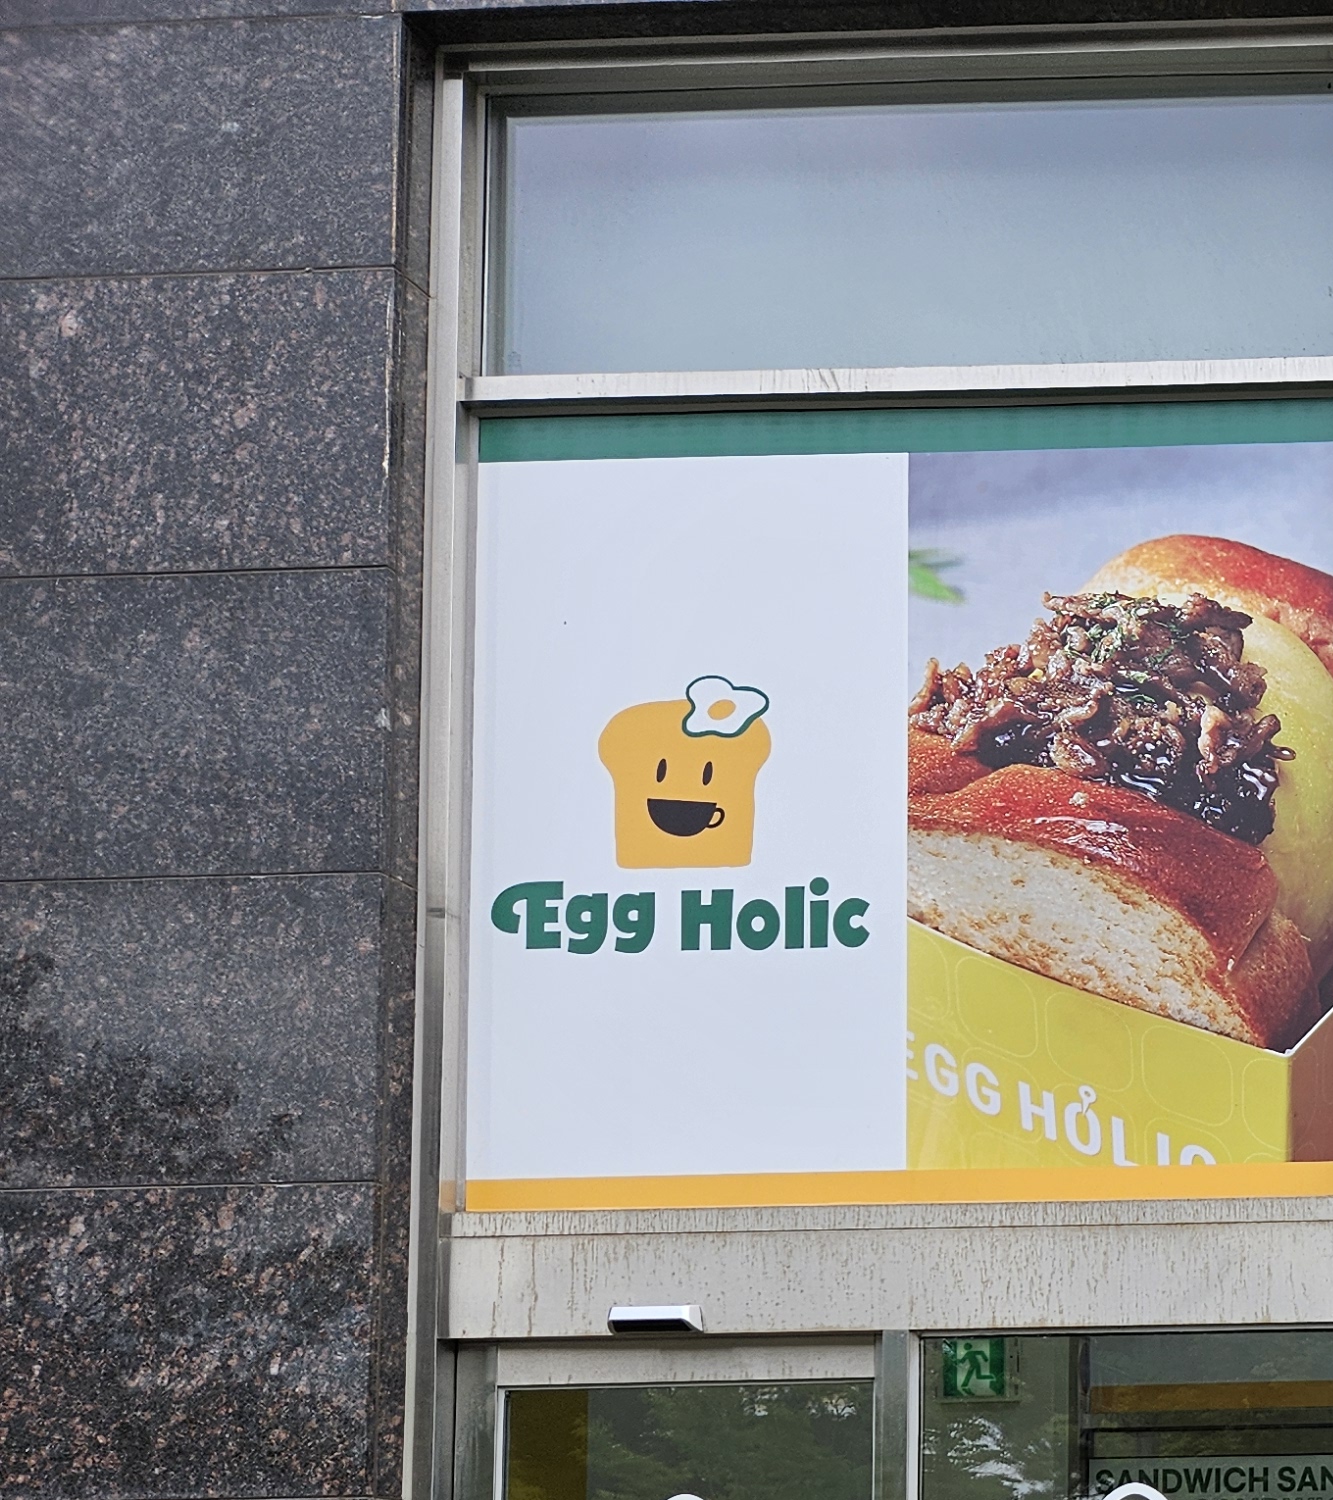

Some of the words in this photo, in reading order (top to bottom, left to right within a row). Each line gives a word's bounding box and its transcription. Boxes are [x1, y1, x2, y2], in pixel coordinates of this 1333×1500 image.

[491, 881, 656, 955] Egg
[680, 877, 871, 952] Holic
[1095, 1466, 1269, 1495] SANDWICH
